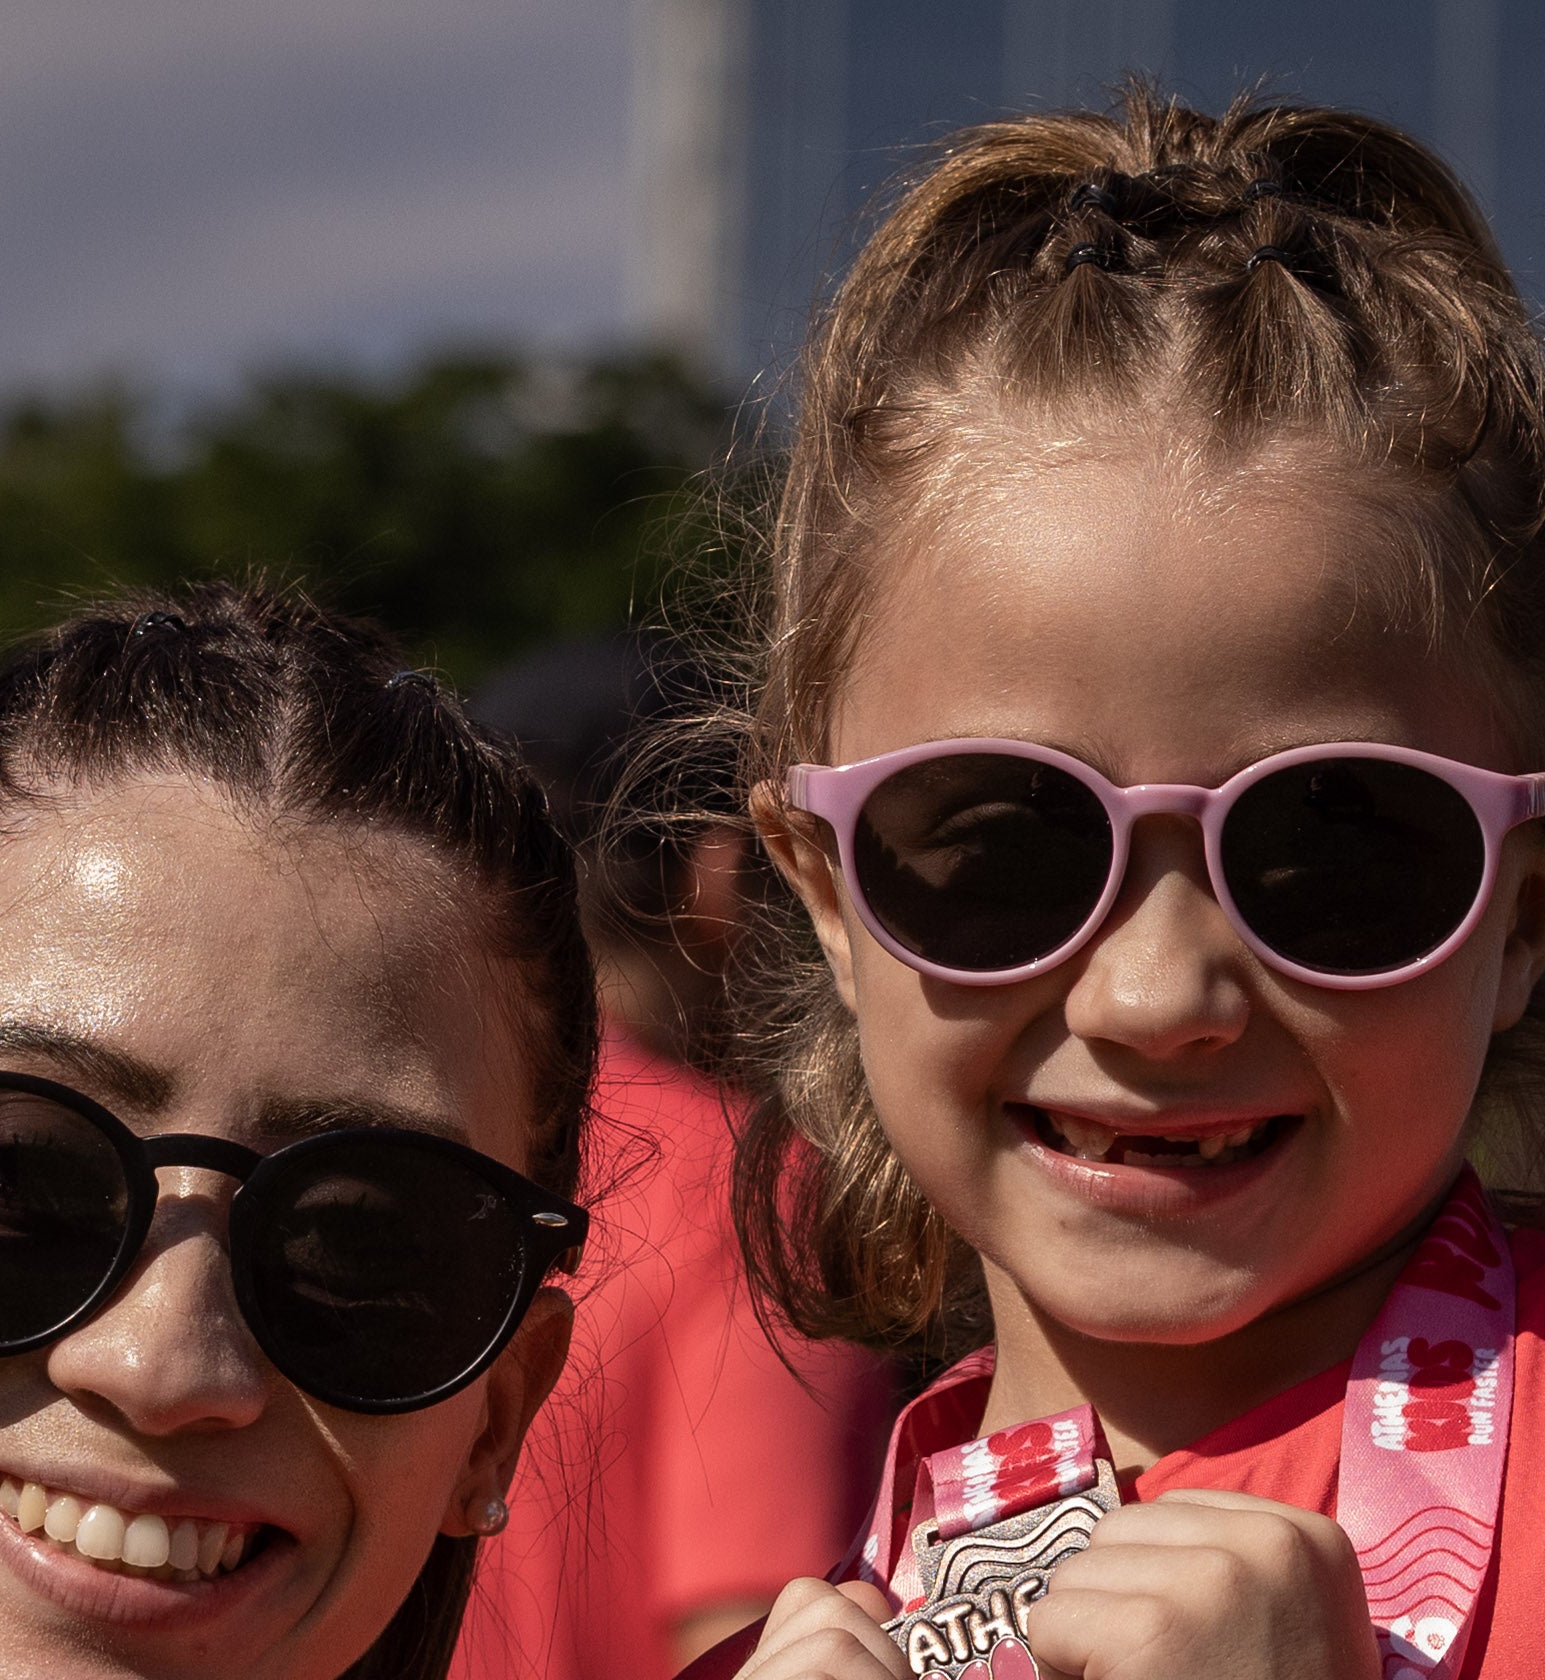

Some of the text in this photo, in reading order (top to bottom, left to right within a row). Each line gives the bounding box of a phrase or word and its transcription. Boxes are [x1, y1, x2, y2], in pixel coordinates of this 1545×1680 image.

[1371, 1336, 1411, 1451] ATHENAS
[1402, 1337, 1476, 1452] KIDS
[1467, 1348, 1500, 1445] RUN FASTER
